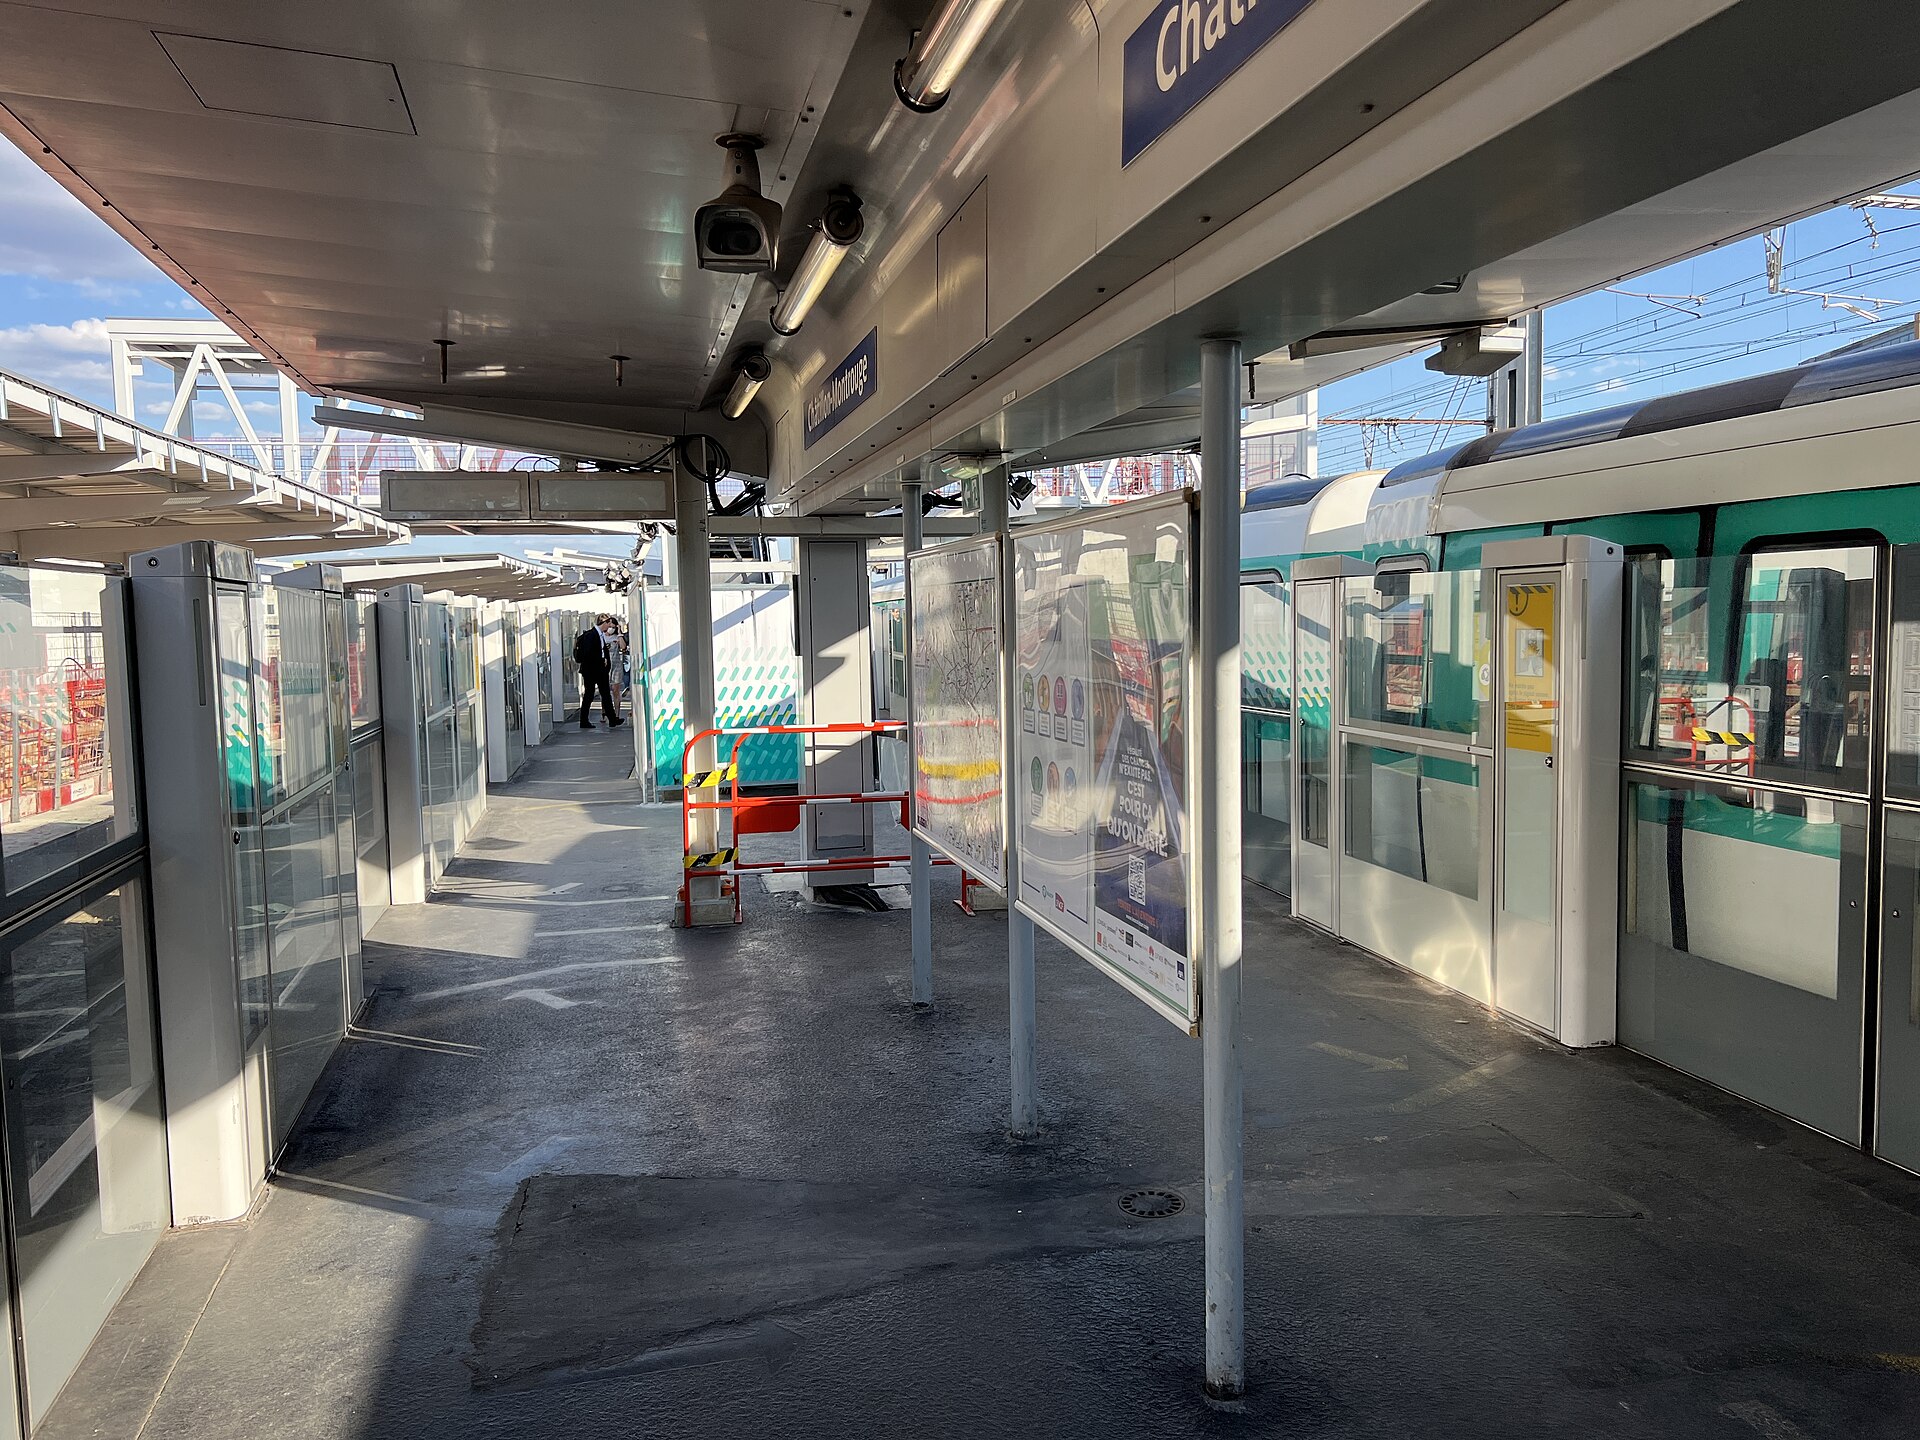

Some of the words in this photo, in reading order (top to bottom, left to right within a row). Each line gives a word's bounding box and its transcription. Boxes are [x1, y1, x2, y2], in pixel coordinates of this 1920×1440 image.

[1127, 781, 1145, 798] C'EST
[1119, 795, 1141, 818] POUR
[1107, 815, 1137, 844] QU'ON
